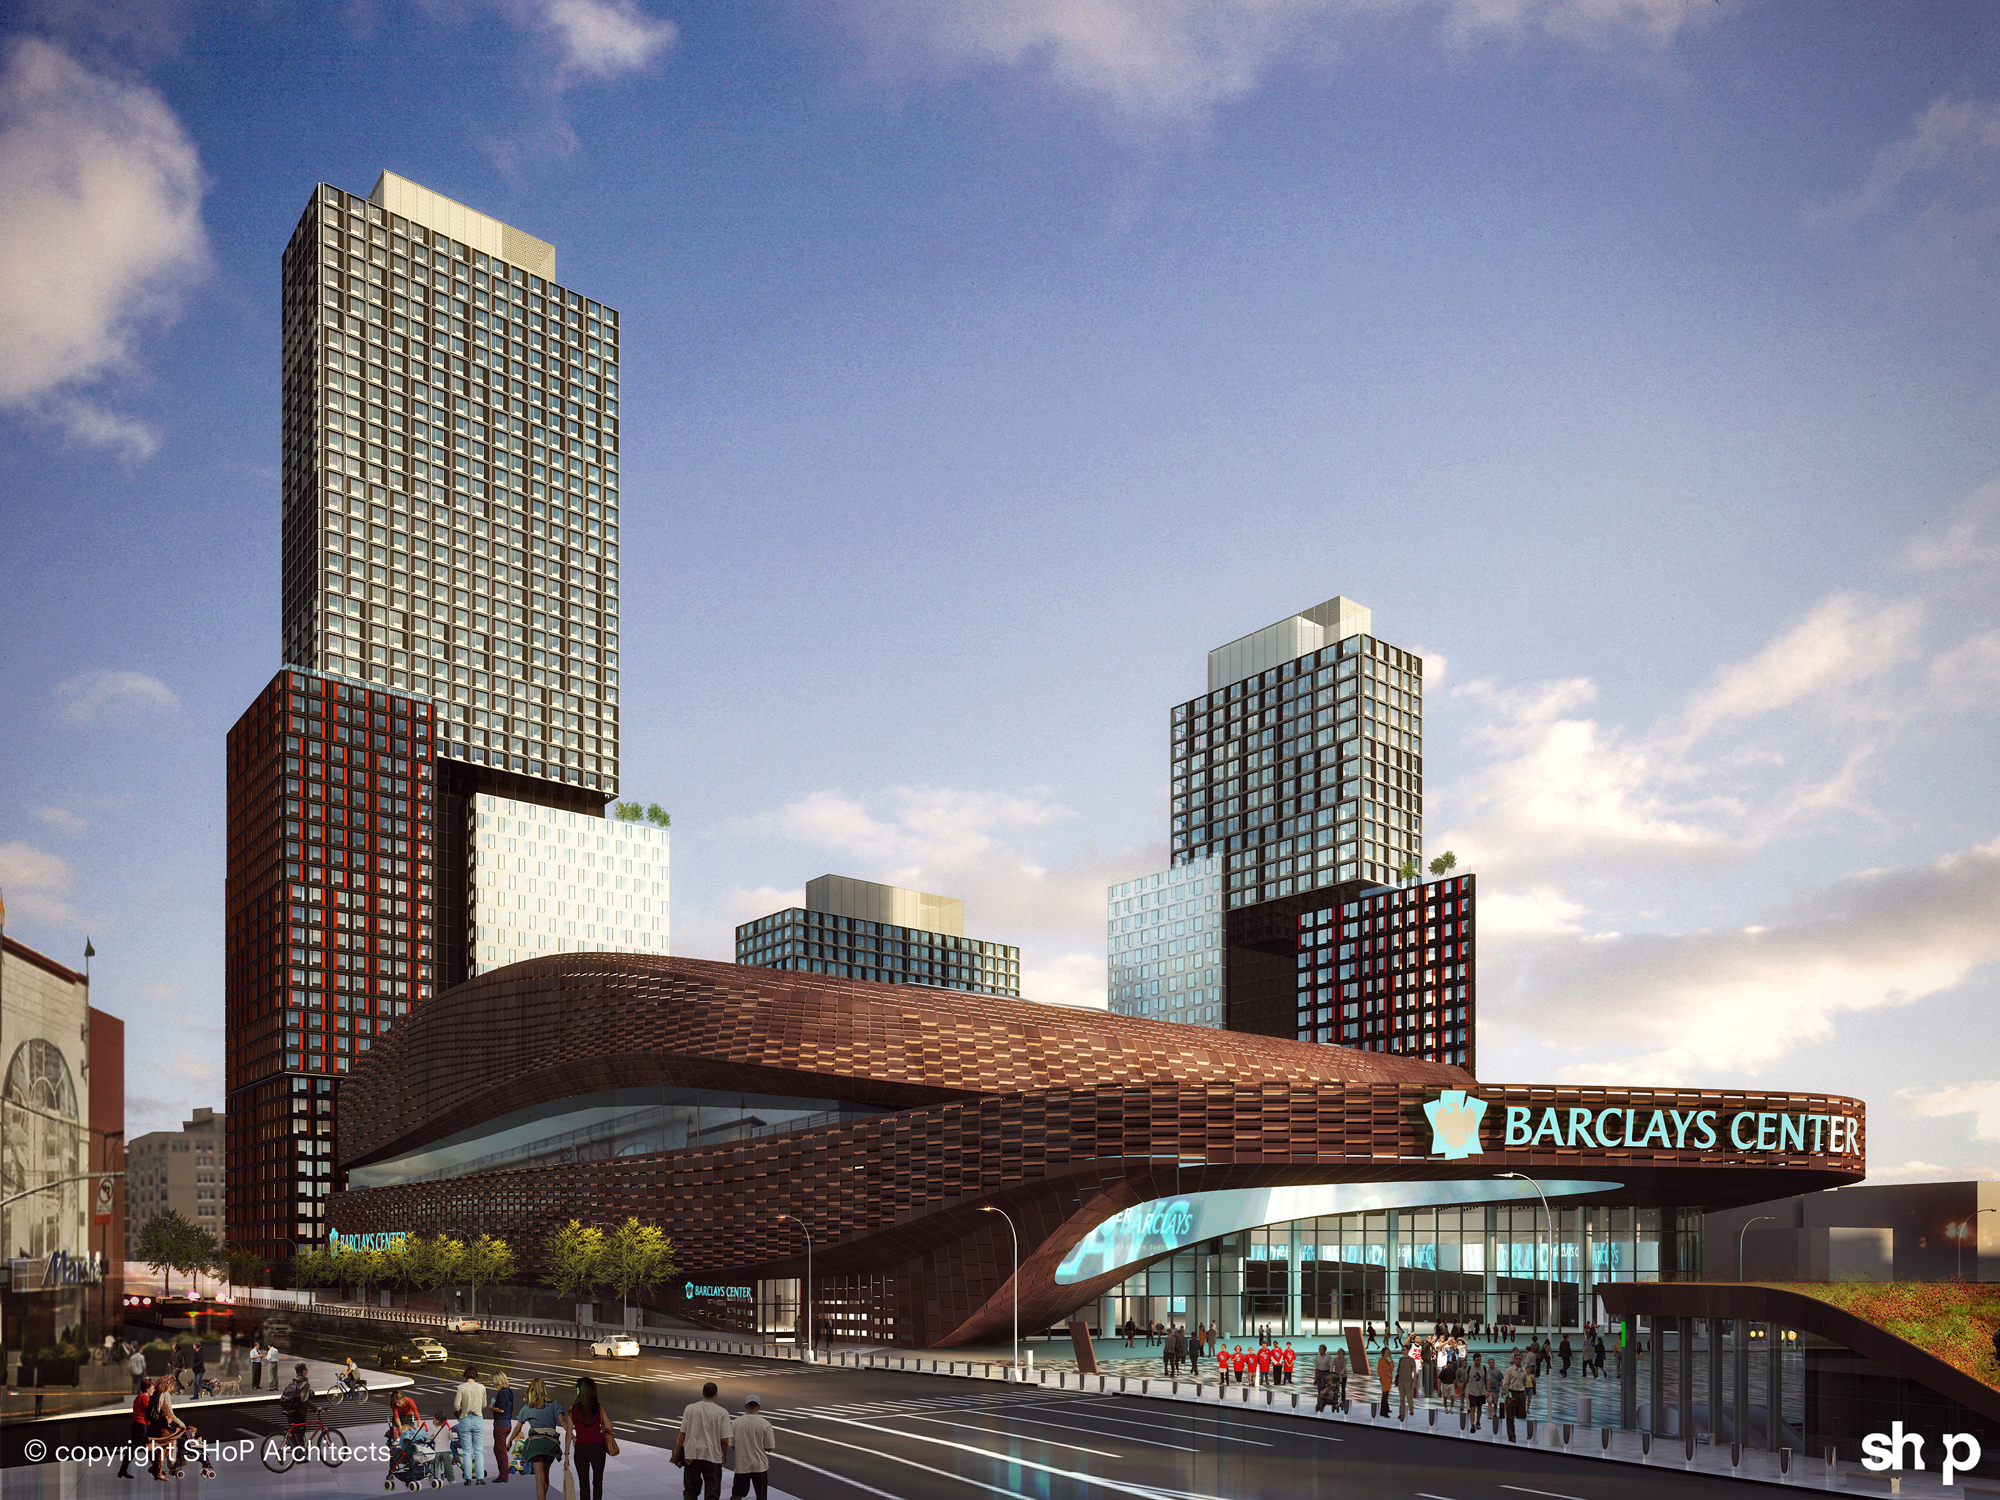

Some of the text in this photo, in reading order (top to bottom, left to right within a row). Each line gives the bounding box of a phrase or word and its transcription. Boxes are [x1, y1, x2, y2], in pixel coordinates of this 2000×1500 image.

[1504, 1106, 1861, 1156] BARCLAYS CENTER
[1120, 1213, 1193, 1235] BARCLAYS
[340, 1232, 406, 1253] BARCLAYS CENTER
[41, 1249, 102, 1287] Marsha
[695, 1285, 752, 1298] BARCLAYS CENTER
